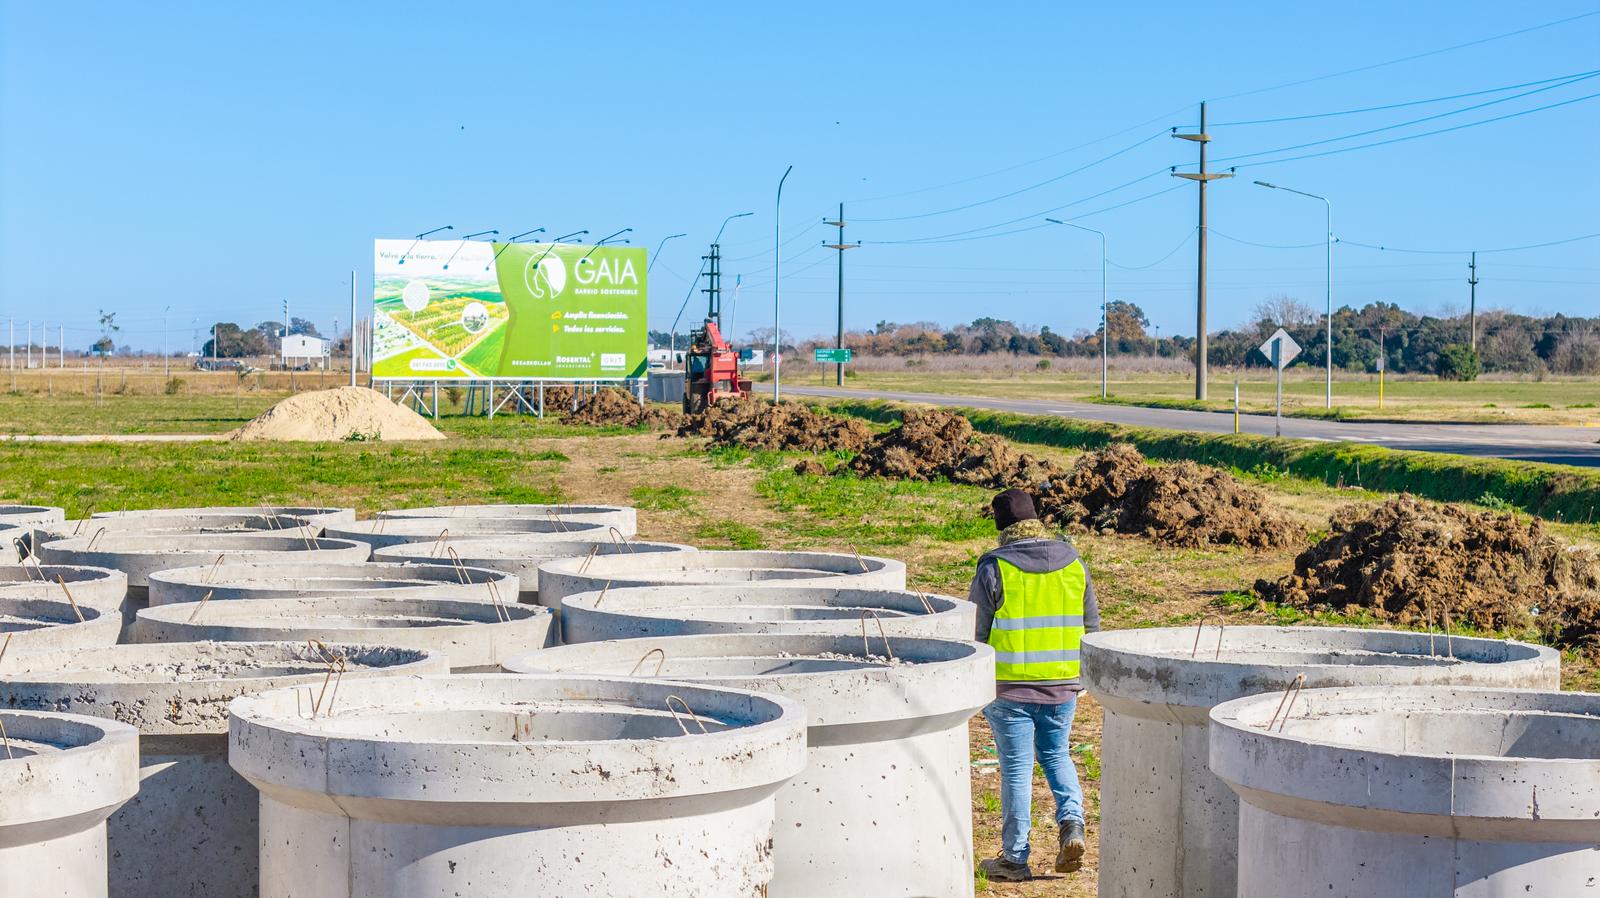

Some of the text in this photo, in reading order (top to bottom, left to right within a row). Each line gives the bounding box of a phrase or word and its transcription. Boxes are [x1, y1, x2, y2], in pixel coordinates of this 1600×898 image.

[575, 257, 639, 285] GAIA
[600, 288, 638, 296] SOSTENIBLE
[564, 324, 583, 333] Todos
[584, 324, 594, 333] los
